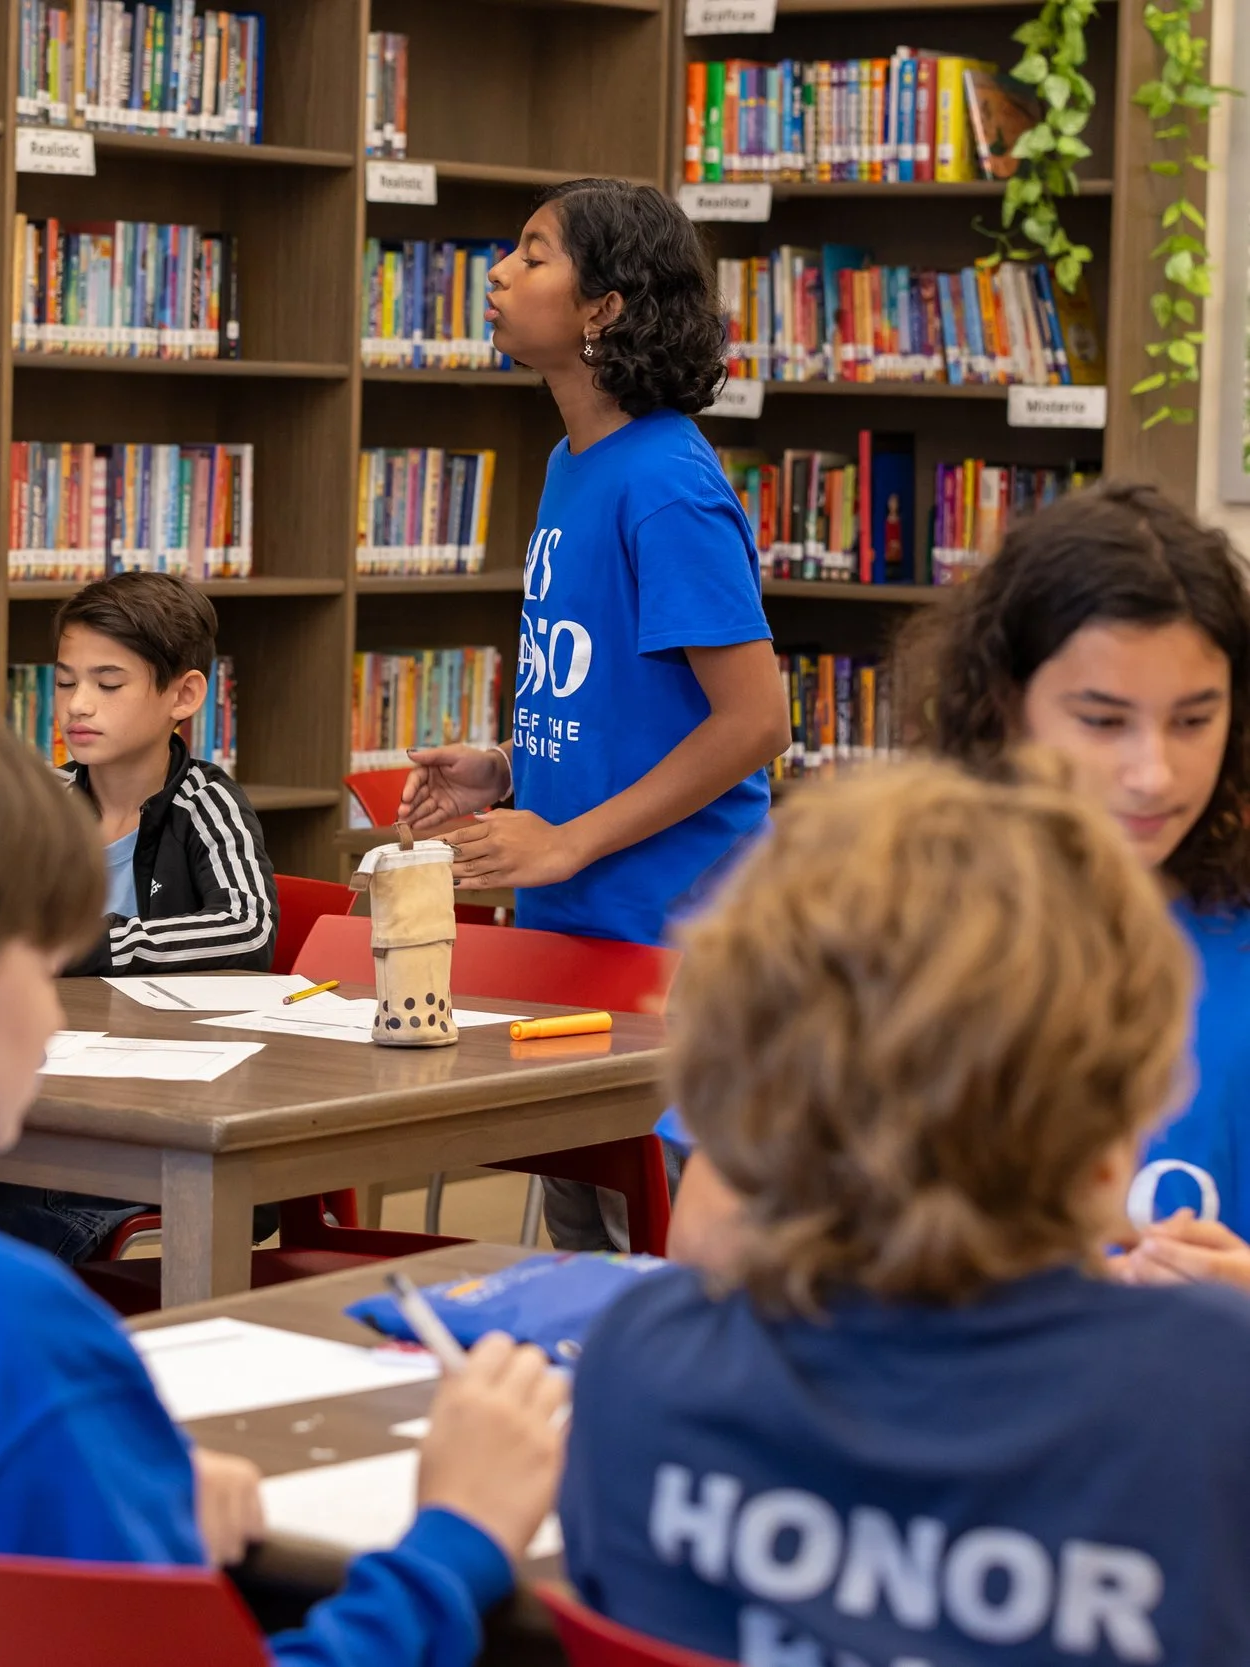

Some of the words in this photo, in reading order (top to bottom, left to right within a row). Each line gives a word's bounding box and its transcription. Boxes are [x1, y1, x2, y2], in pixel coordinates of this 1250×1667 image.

[30, 141, 80, 159] Realistic
[380, 174, 423, 191] Realistic
[1025, 401, 1085, 414] Misterio
[653, 1462, 1163, 1662] HONOR
